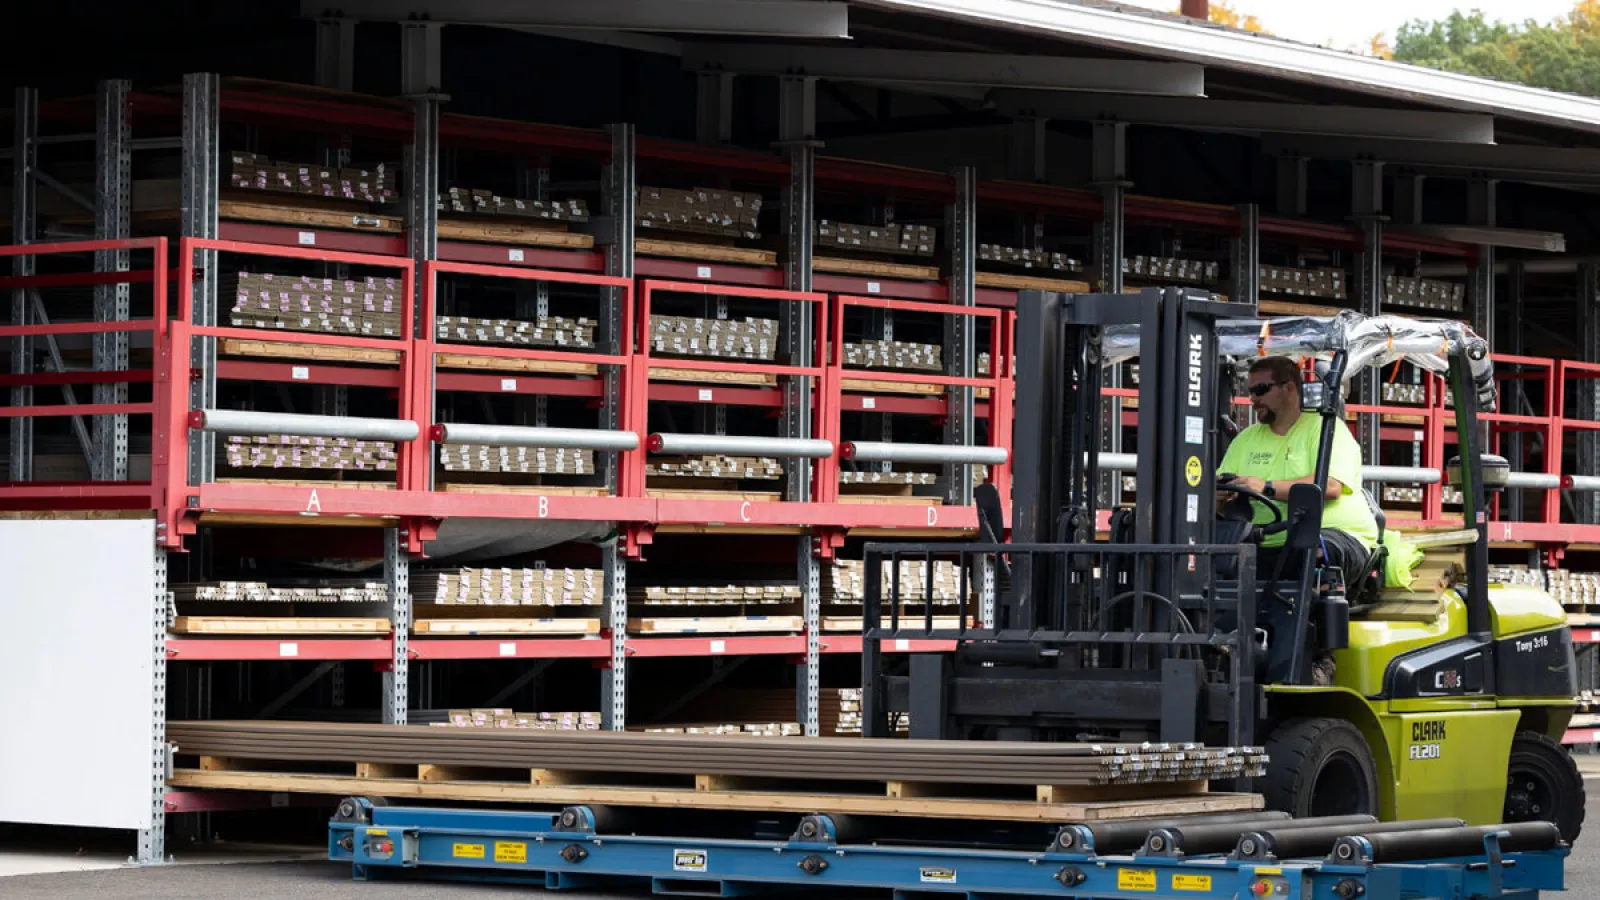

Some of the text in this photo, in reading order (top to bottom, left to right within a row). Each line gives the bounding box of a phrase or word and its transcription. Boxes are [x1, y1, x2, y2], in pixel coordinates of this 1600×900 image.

[1188, 334, 1202, 407] CLARK
[307, 488, 321, 512] A
[539, 496, 549, 517] B
[741, 501, 751, 522] C
[927, 507, 938, 527] D
[1503, 522, 1512, 540] H
[1516, 635, 1549, 653] Tony 3:16
[1412, 720, 1446, 741] CLARK
[1409, 744, 1440, 760] FL201
